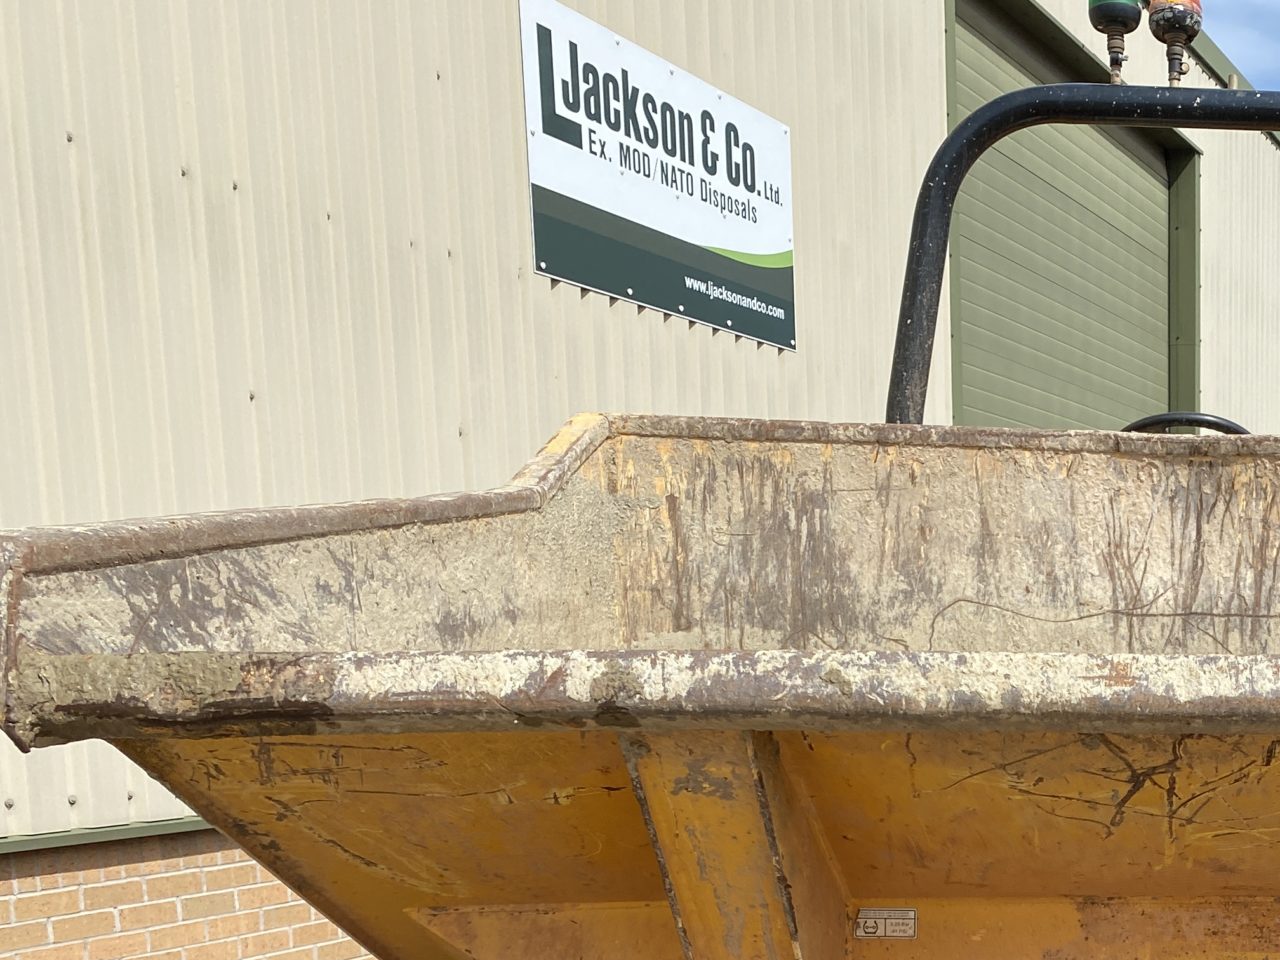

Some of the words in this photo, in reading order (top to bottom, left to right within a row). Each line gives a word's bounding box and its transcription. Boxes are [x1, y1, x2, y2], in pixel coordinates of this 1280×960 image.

[588, 127, 612, 163] Ex.
[700, 177, 758, 224] Disposals
[701, 109, 719, 176] &
[725, 121, 761, 197] Co.
[764, 180, 784, 207] Ltd.
[684, 275, 785, 320] www.ljacksonandco.com
